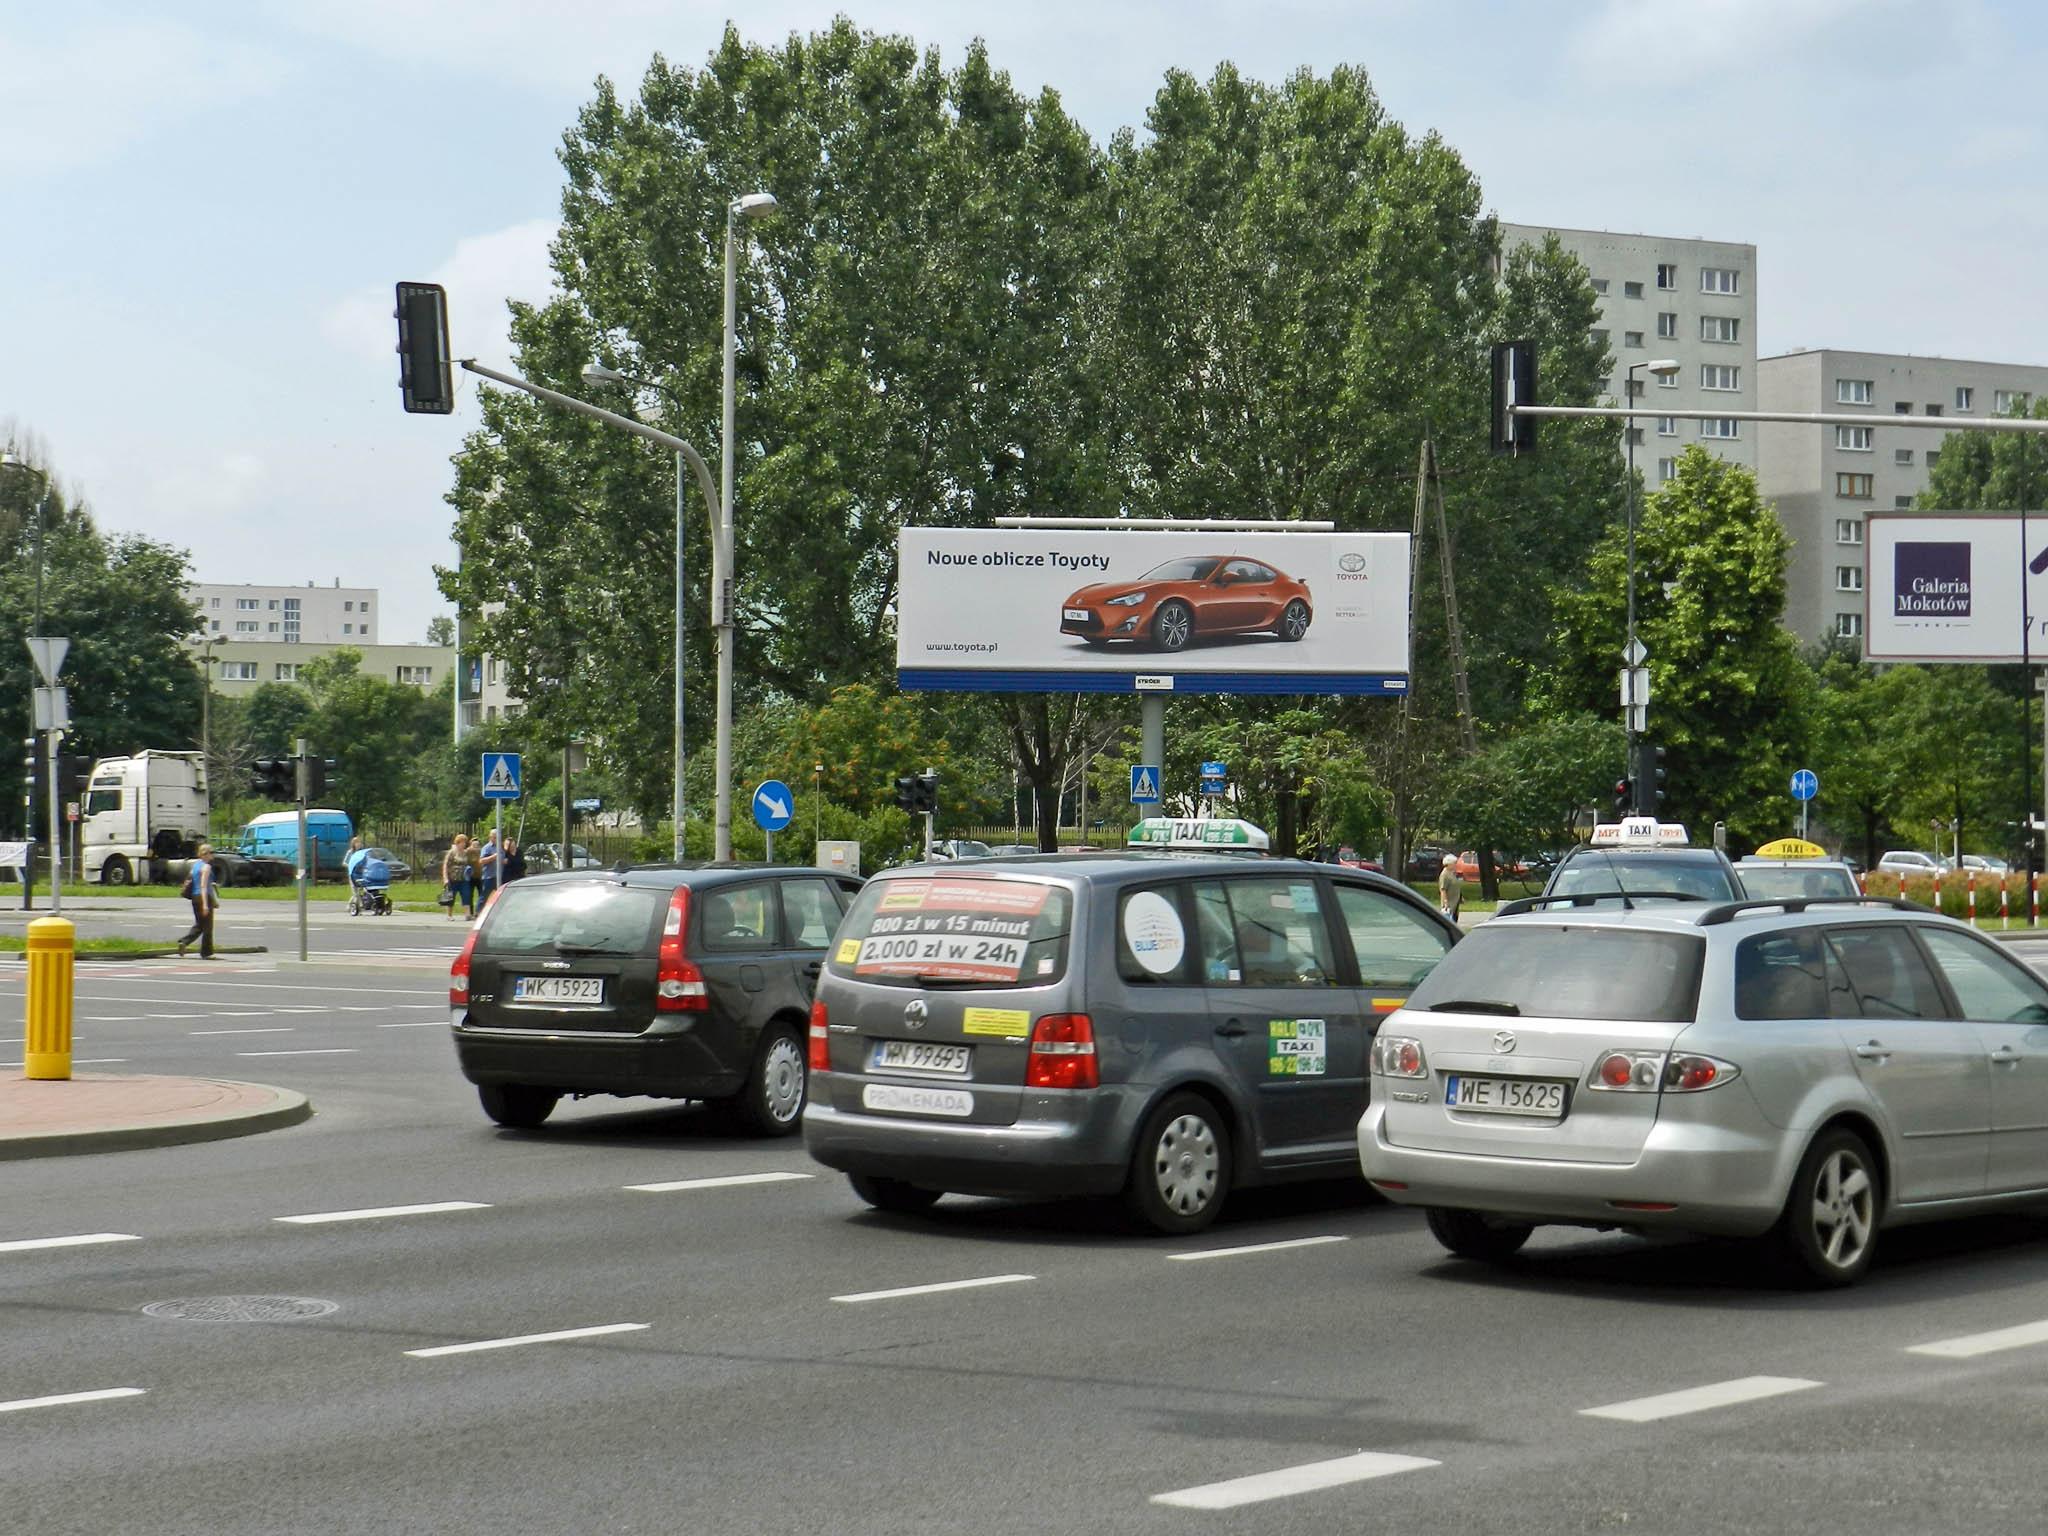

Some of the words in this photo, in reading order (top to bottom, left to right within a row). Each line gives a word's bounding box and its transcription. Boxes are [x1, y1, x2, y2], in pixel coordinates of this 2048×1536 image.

[928, 550, 977, 566] Nowe
[982, 552, 1045, 567] oblicze
[1049, 551, 1110, 571] Toyoty
[1336, 573, 1368, 581] TOYOTA
[1912, 577, 1969, 594] Galeria
[1898, 595, 1969, 611] Mokotów
[926, 642, 998, 653] www.toyota.pl
[1175, 822, 1204, 841] TAXI
[1598, 828, 1620, 837] MPT
[1628, 824, 1652, 835] TAXI
[1782, 843, 1804, 853] TAXI
[871, 916, 902, 934] 800
[904, 915, 919, 931] zł
[924, 918, 942, 931] w
[946, 915, 969, 931] 15
[972, 917, 1031, 936] minut
[864, 939, 918, 961] 2.000
[923, 939, 943, 958] zł
[950, 945, 968, 959] w
[974, 941, 1018, 964] 24h
[526, 979, 547, 996] WK
[554, 979, 600, 997] 15923
[1280, 1041, 1314, 1052] TAXI
[912, 1045, 967, 1069] 99695
[869, 1088, 968, 1112] PROMENADA
[1461, 1080, 1491, 1104] WE
[1500, 1082, 1561, 1109] 1562S
